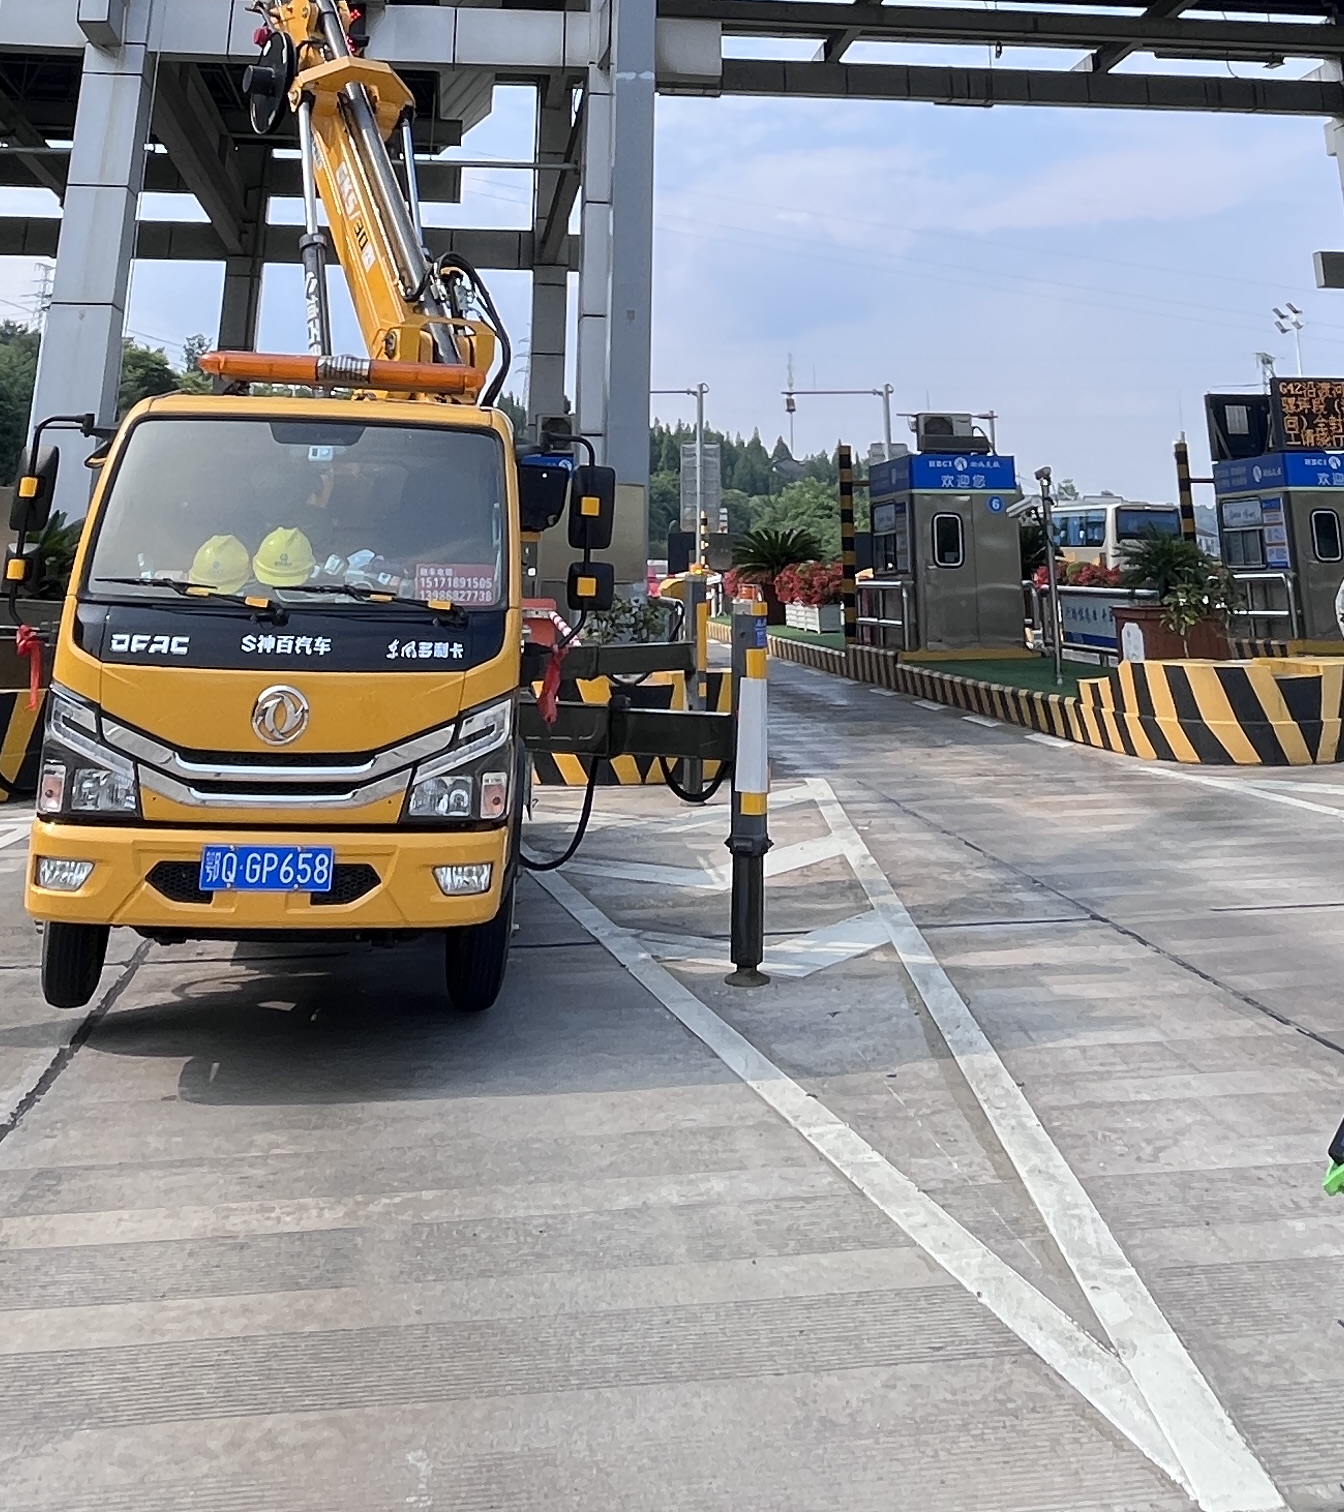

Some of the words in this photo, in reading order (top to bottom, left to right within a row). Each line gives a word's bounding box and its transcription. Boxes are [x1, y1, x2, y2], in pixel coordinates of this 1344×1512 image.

[941, 474, 986, 488] 欢迎您
[109, 634, 191, 655] DFAC
[385, 639, 464, 660] 东风多利卡
